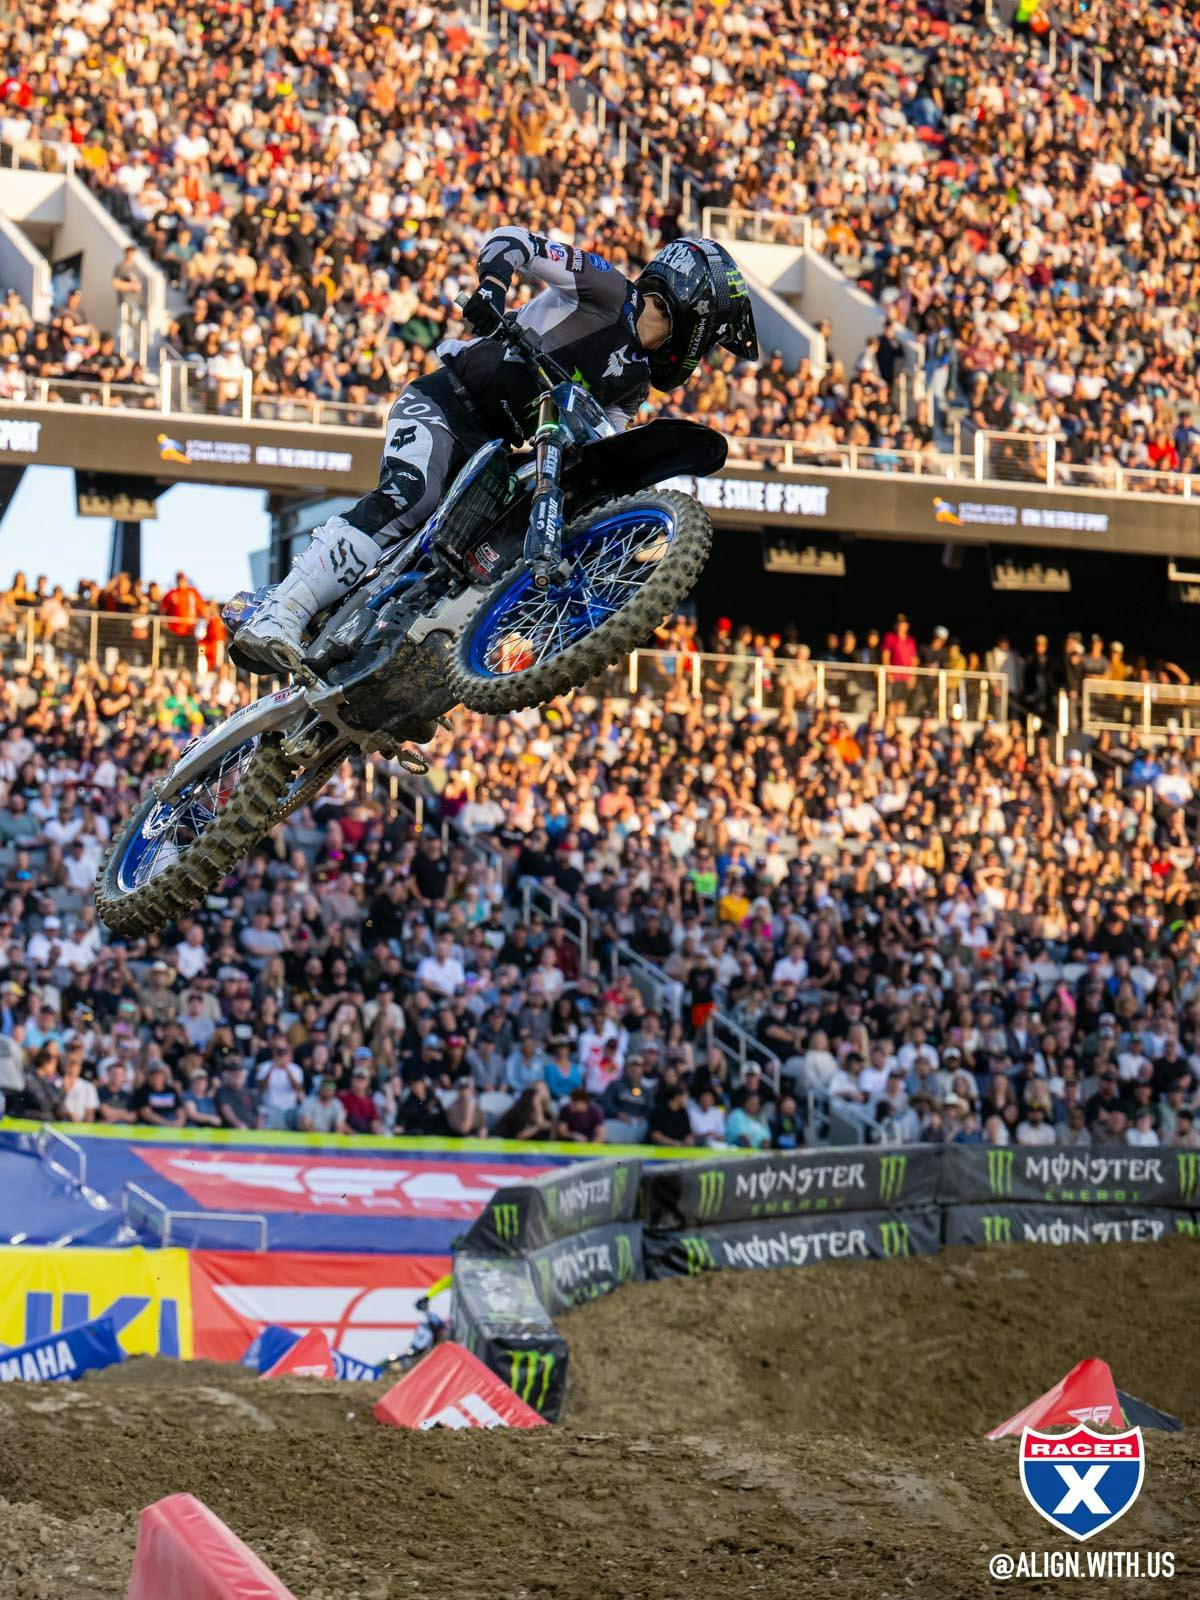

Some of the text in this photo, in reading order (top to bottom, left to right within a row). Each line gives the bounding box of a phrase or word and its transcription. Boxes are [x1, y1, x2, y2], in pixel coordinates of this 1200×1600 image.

[391, 393, 449, 429] FOX
[723, 479, 766, 511] STATE
[766, 482, 785, 513] OF
[783, 484, 829, 516] SPORT
[545, 497, 558, 542] DUNLOP
[736, 1163, 865, 1200] MONSTER
[1025, 1152, 1164, 1185] MONSTER
[722, 1229, 869, 1268] MONSTER
